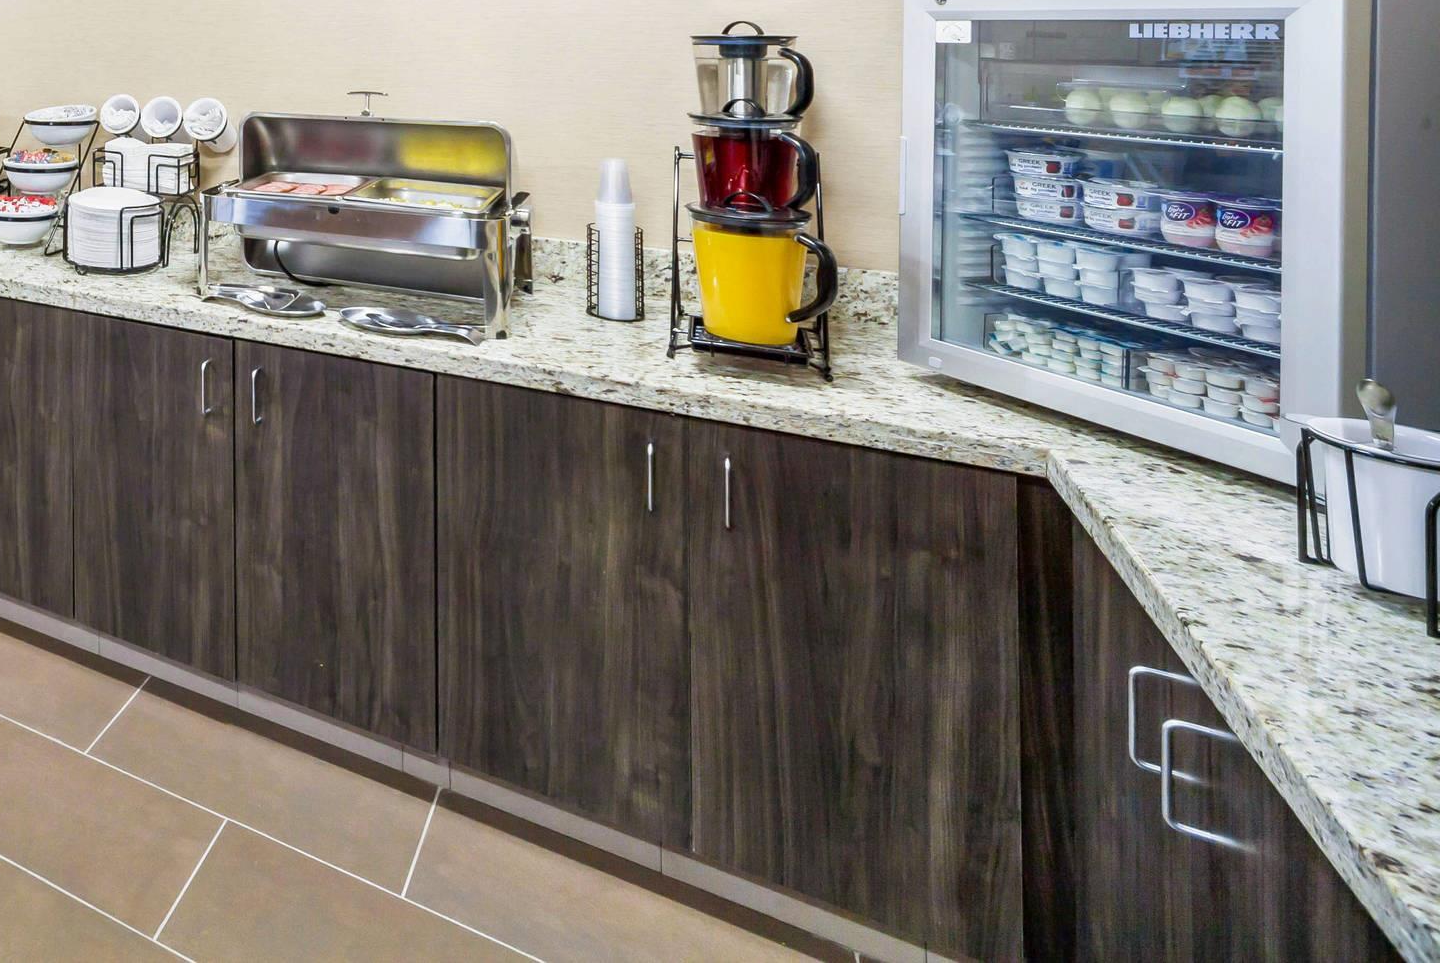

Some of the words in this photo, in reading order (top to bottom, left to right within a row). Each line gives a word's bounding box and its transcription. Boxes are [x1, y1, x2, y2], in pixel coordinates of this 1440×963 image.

[1129, 23, 1280, 39] LIEBHERR
[1031, 181, 1056, 189] GREEK
[1089, 188, 1111, 196] GREEK
[1090, 210, 1112, 218] GREEK
